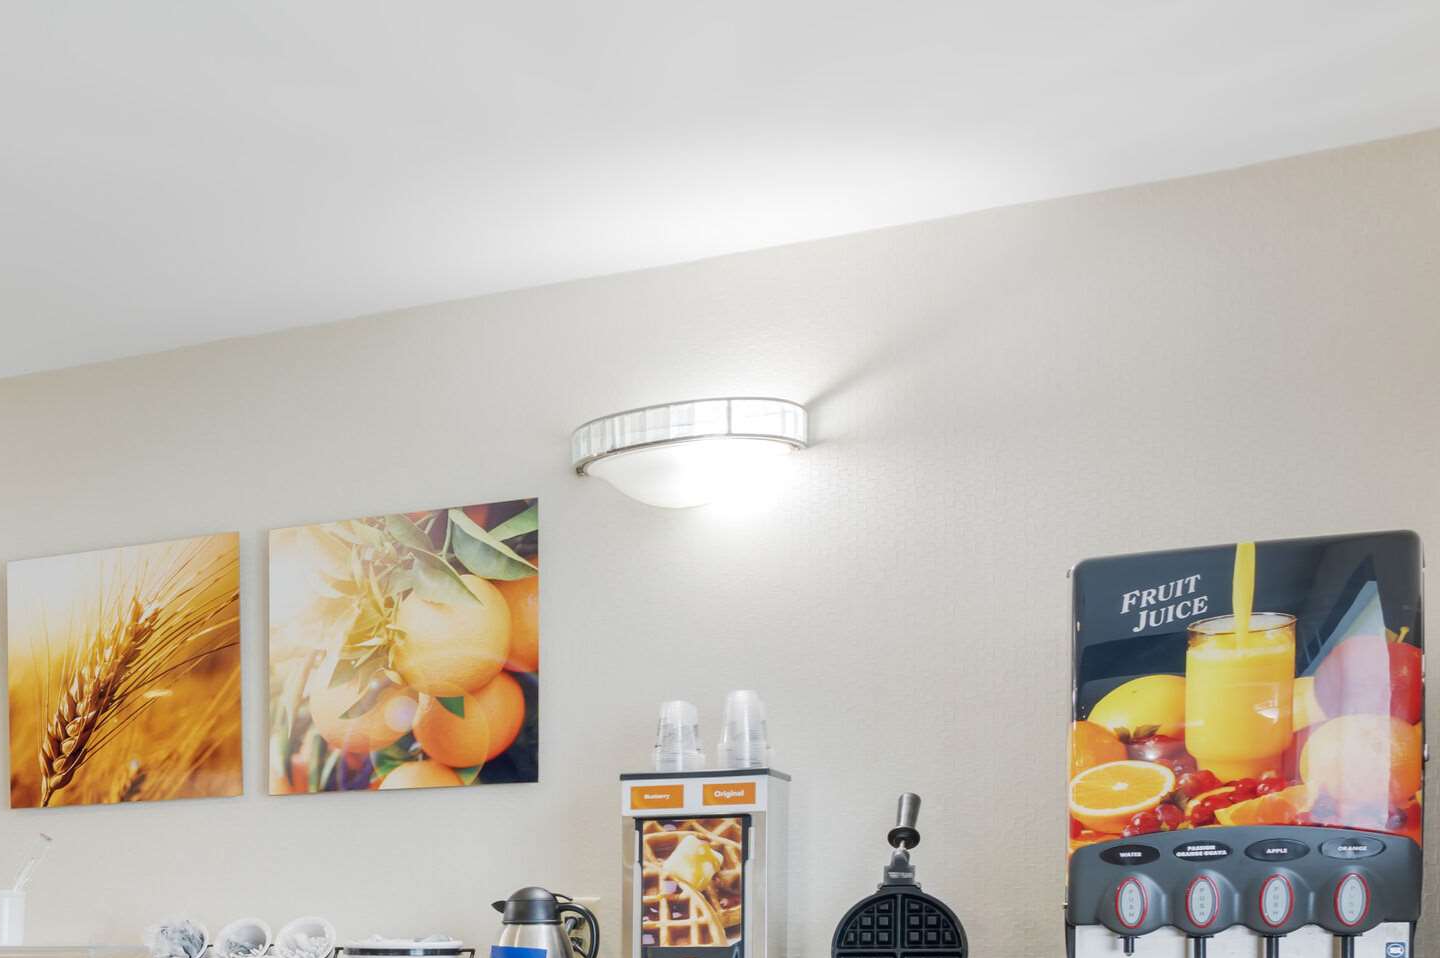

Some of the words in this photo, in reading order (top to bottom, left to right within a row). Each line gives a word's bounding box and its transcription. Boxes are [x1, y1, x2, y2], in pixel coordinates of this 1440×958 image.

[1120, 574, 1201, 614] FRUIT
[1132, 595, 1208, 633] JUICE
[714, 790, 744, 799] Original
